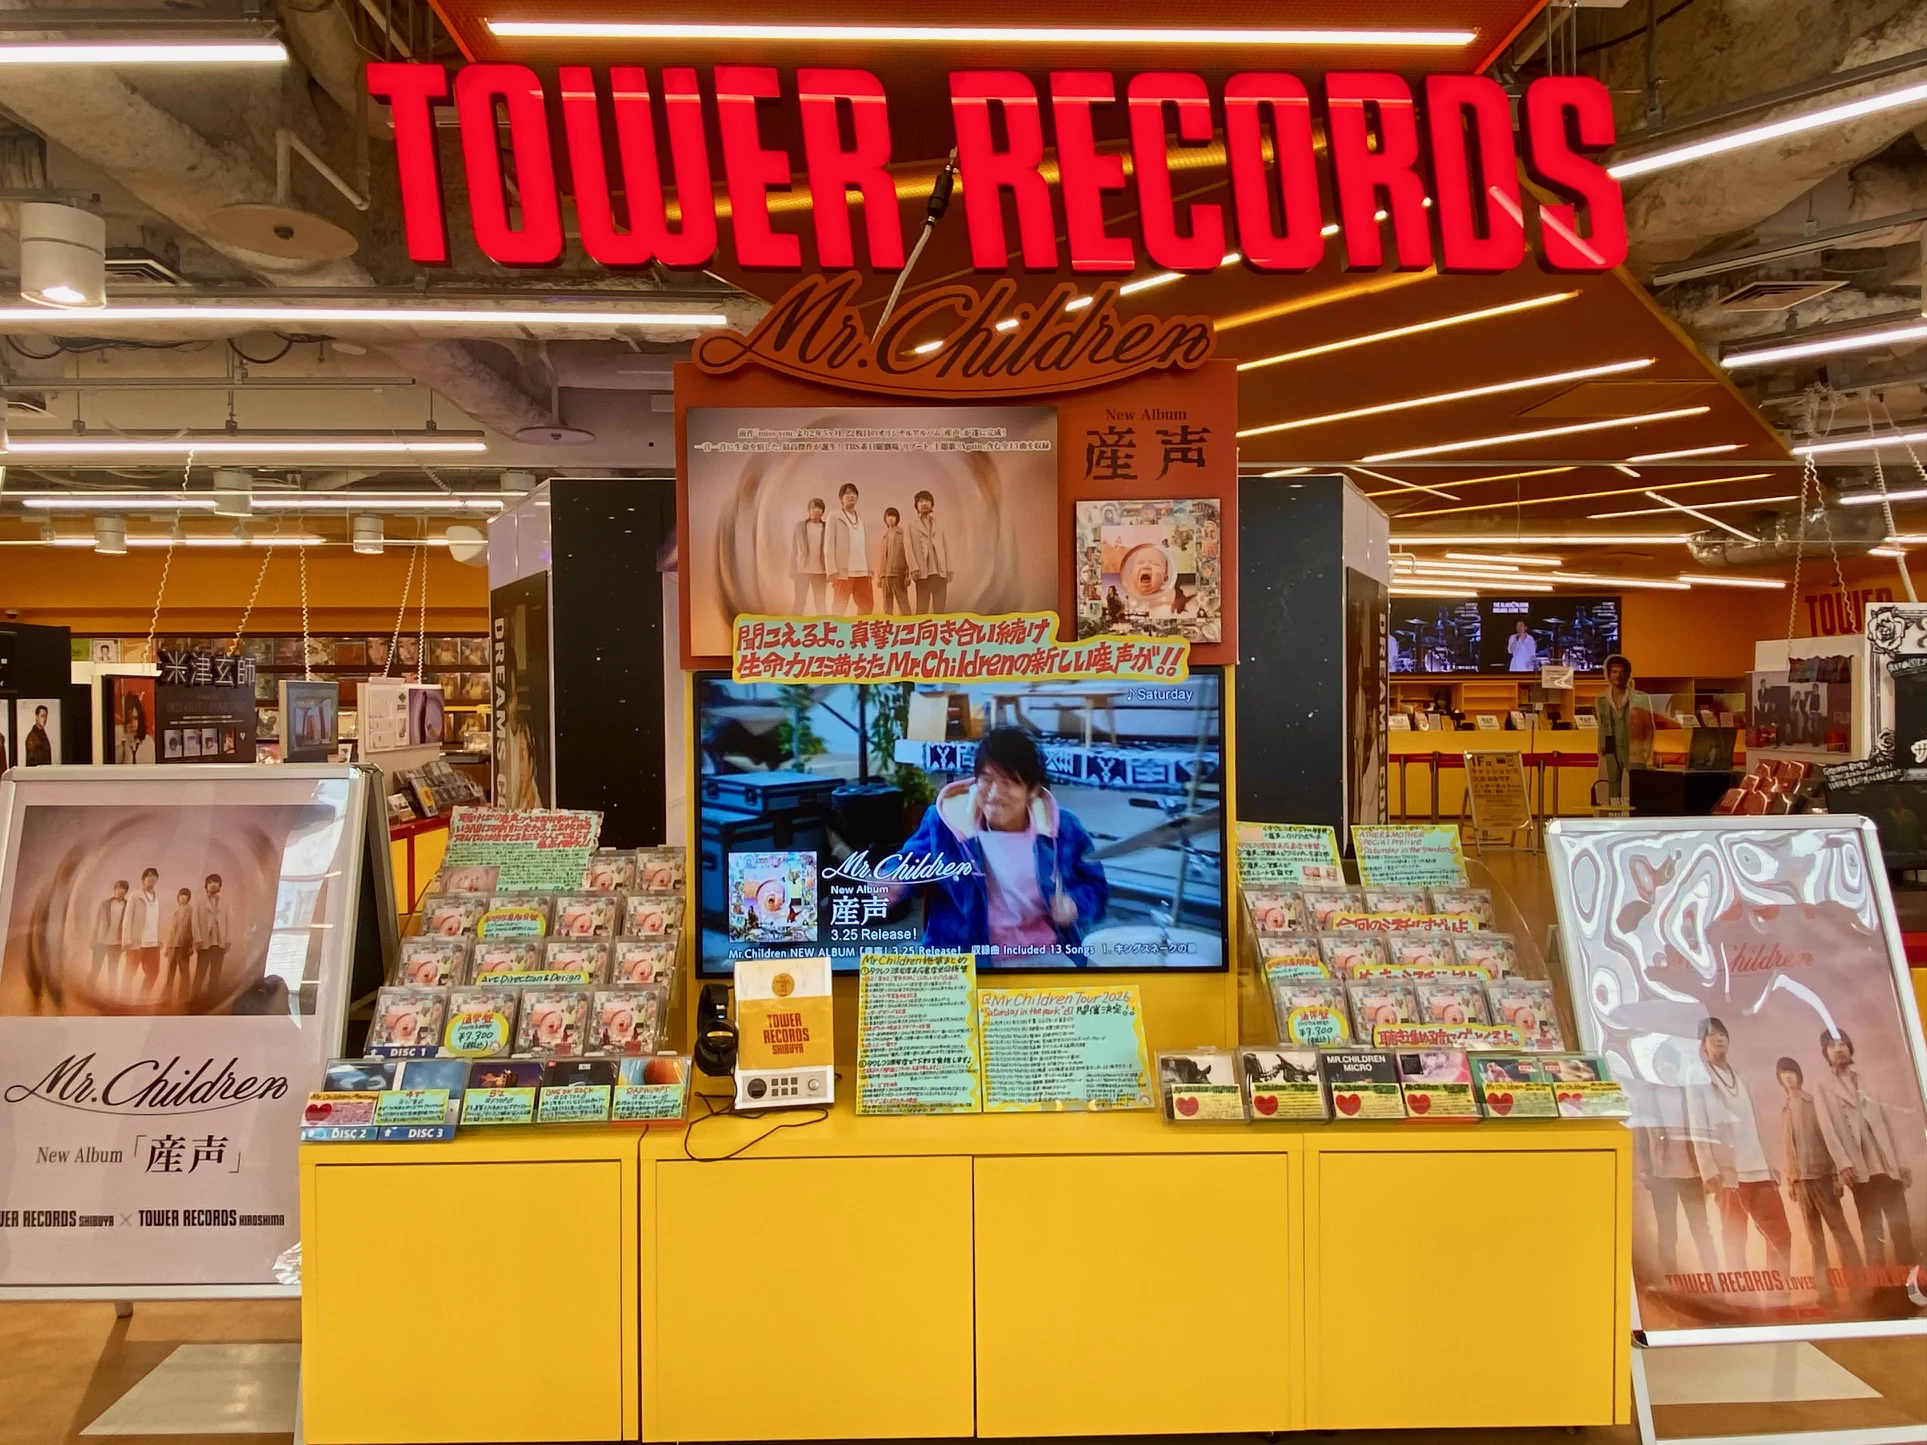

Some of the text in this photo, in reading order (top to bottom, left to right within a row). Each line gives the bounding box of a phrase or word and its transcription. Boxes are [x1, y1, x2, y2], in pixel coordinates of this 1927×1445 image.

[366, 63, 1628, 273] TOWER RECORDS
[1106, 407, 1188, 422] New Album
[1083, 424, 1211, 482] 産声
[165, 652, 256, 688] 米津玄師
[493, 617, 507, 762] DREAMS
[1378, 613, 1387, 756] DREAMS
[1137, 688, 1193, 702] Saturday
[831, 885, 889, 894] New Album
[830, 896, 889, 926] 産声
[831, 928, 917, 941] 3.25 Release!
[729, 949, 787, 959] Mr.Children
[790, 948, 817, 958] NEW
[818, 948, 855, 958] ALBUM
[893, 947, 915, 955] 3.25
[1003, 944, 1046, 955] Included
[1050, 945, 1062, 954] 13
[1065, 945, 1095, 956] Songs
[1076, 991, 1101, 1004] Tour
[1102, 991, 1131, 1002] 2026
[766, 1013, 802, 1028] TOWER
[763, 1028, 810, 1043] RECORDS
[389, 1048, 418, 1058] DISC
[772, 1043, 804, 1055] SHIBUYA
[1327, 1055, 1386, 1064] MR.CHILDREN
[1343, 1064, 1373, 1072] MICRO
[331, 1129, 367, 1138] DISC 2
[408, 1128, 443, 1138] DISC 3
[36, 1134, 242, 1174] New Album 「産声」
[23, 1210, 77, 1227] RECORDS
[79, 1215, 115, 1227] SHIBUYA
[138, 1210, 179, 1226] TOWER
[183, 1209, 237, 1226] RECORDS
[1665, 1273, 1717, 1295] TOWER
[1717, 1270, 1784, 1293] RECORDS
[1785, 1276, 1817, 1291] LOVES
